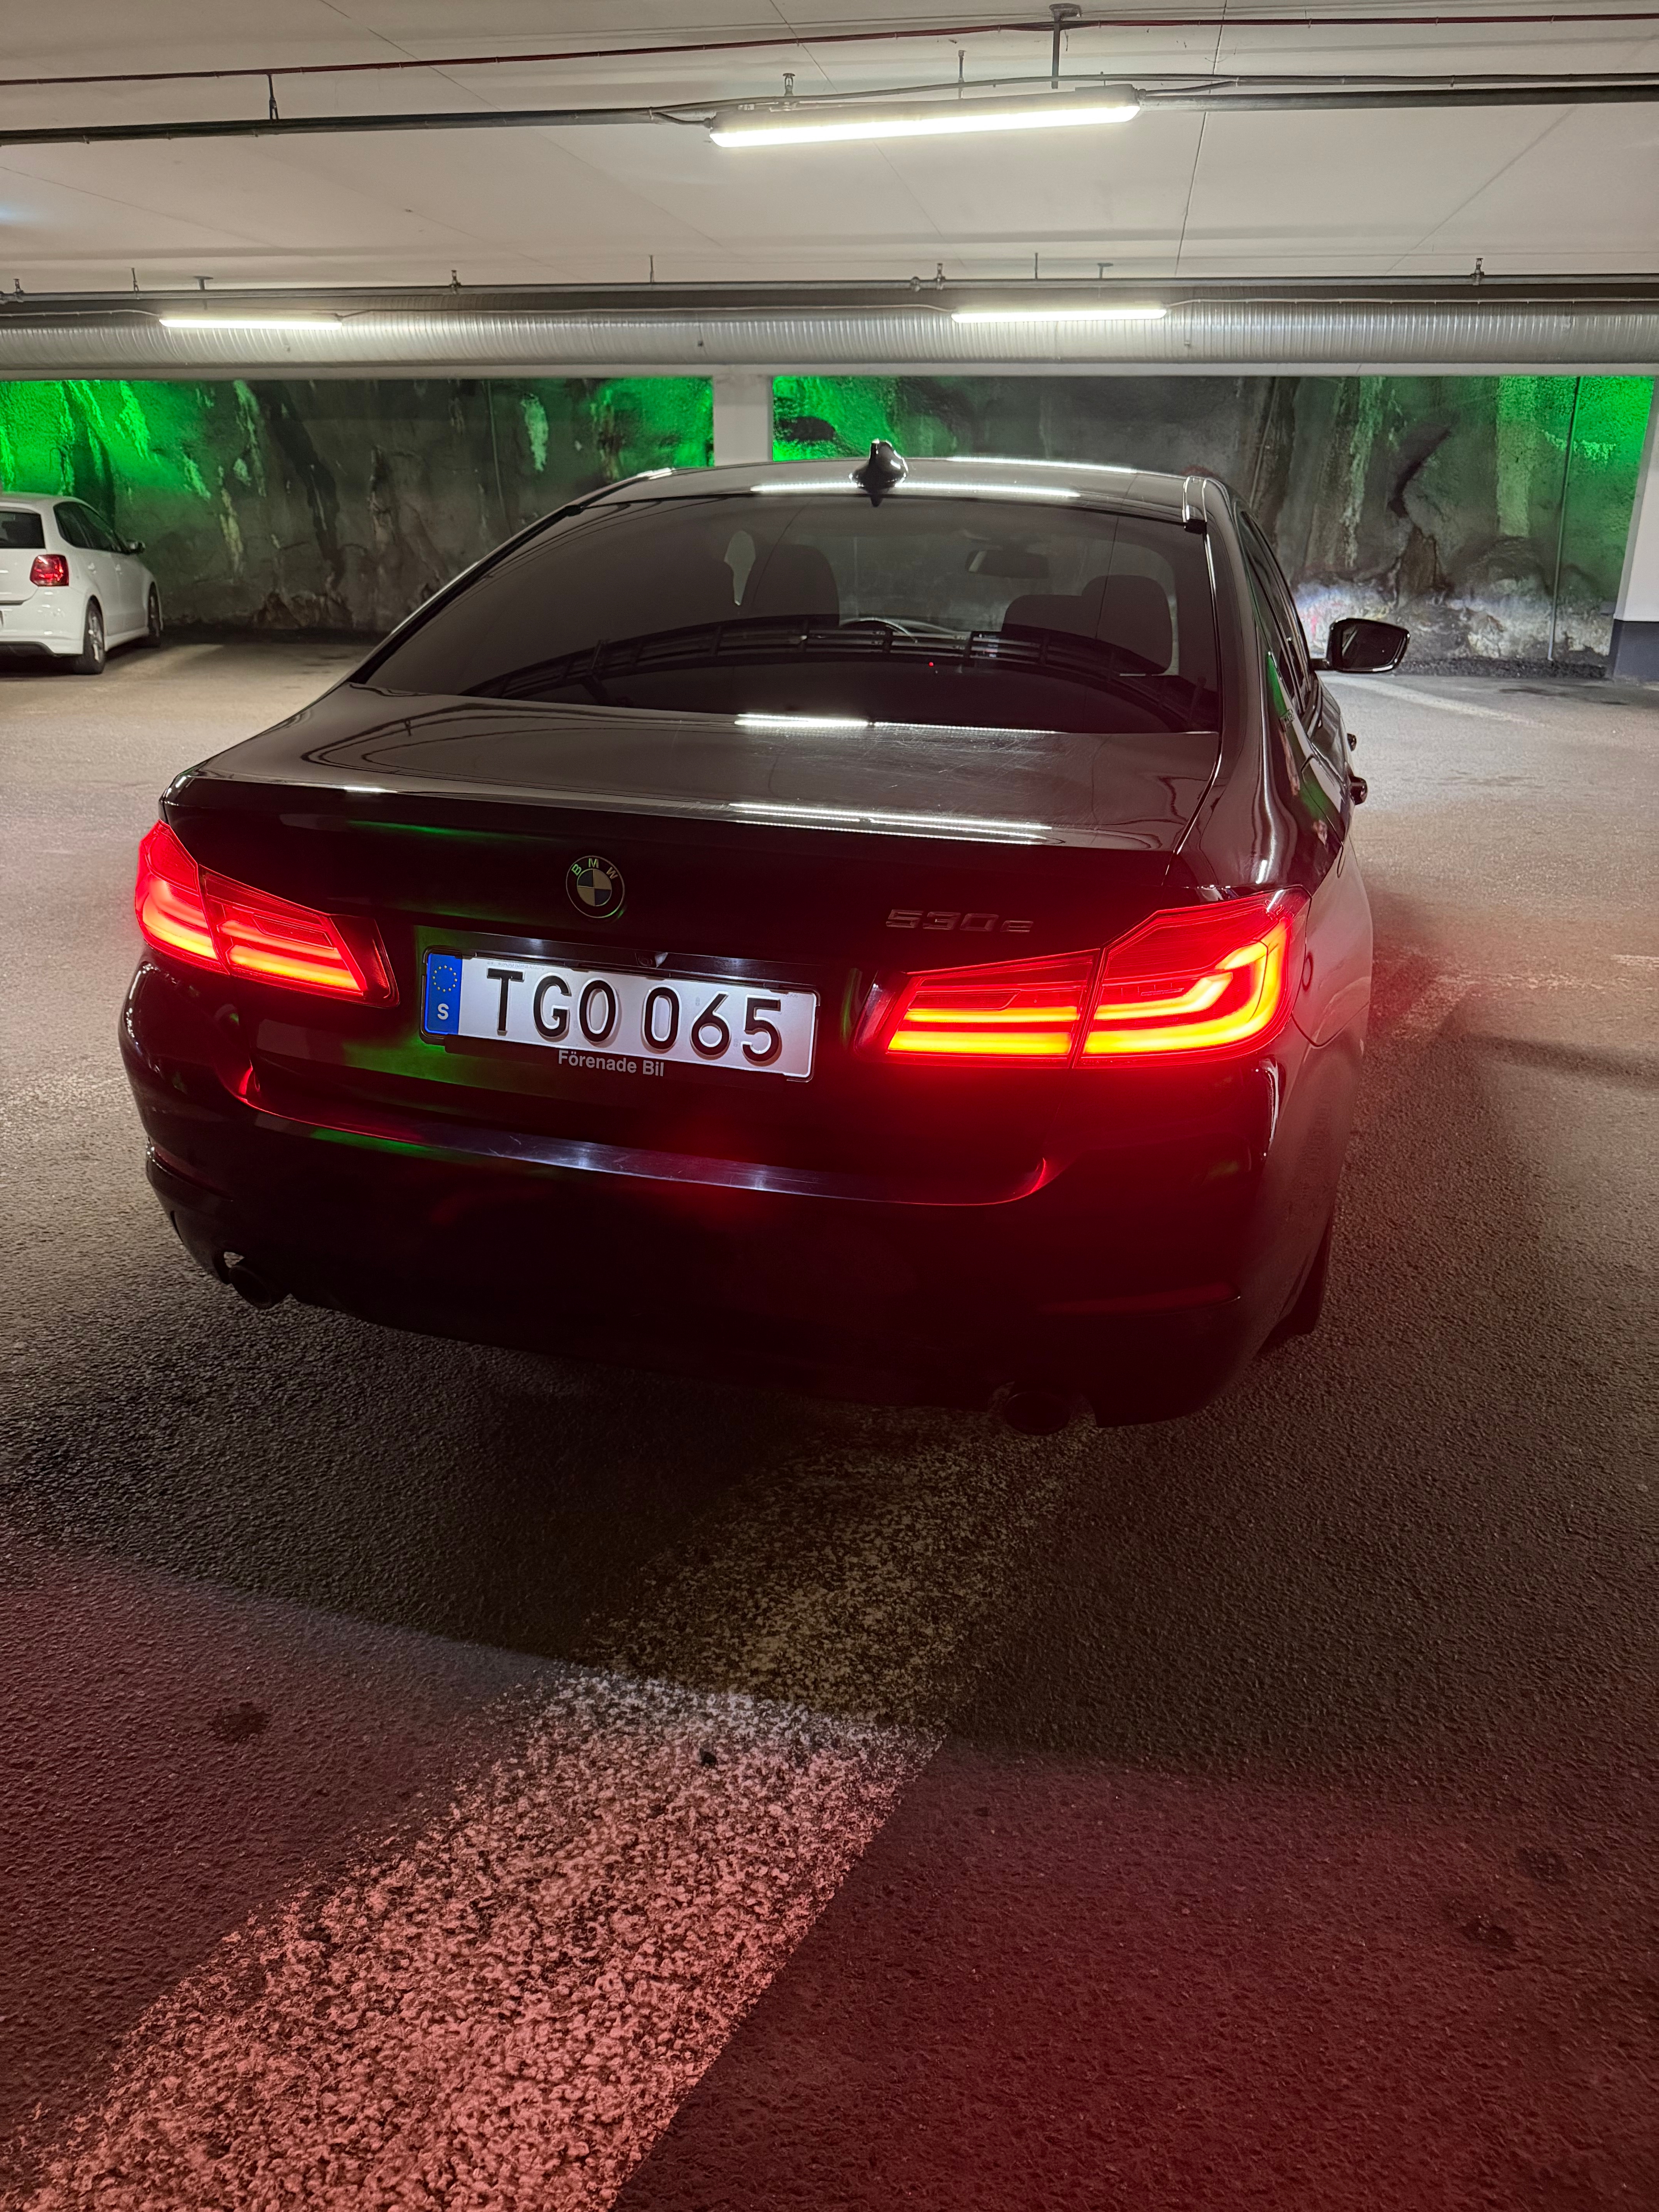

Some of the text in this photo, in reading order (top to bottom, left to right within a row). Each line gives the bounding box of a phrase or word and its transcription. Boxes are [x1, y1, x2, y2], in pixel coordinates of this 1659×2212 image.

[571, 858, 618, 879] BMW
[886, 909, 1034, 933] 530e
[437, 1003, 449, 1020] S
[487, 968, 781, 1062] TGO 065
[558, 1050, 672, 1077] Förenade Bil
